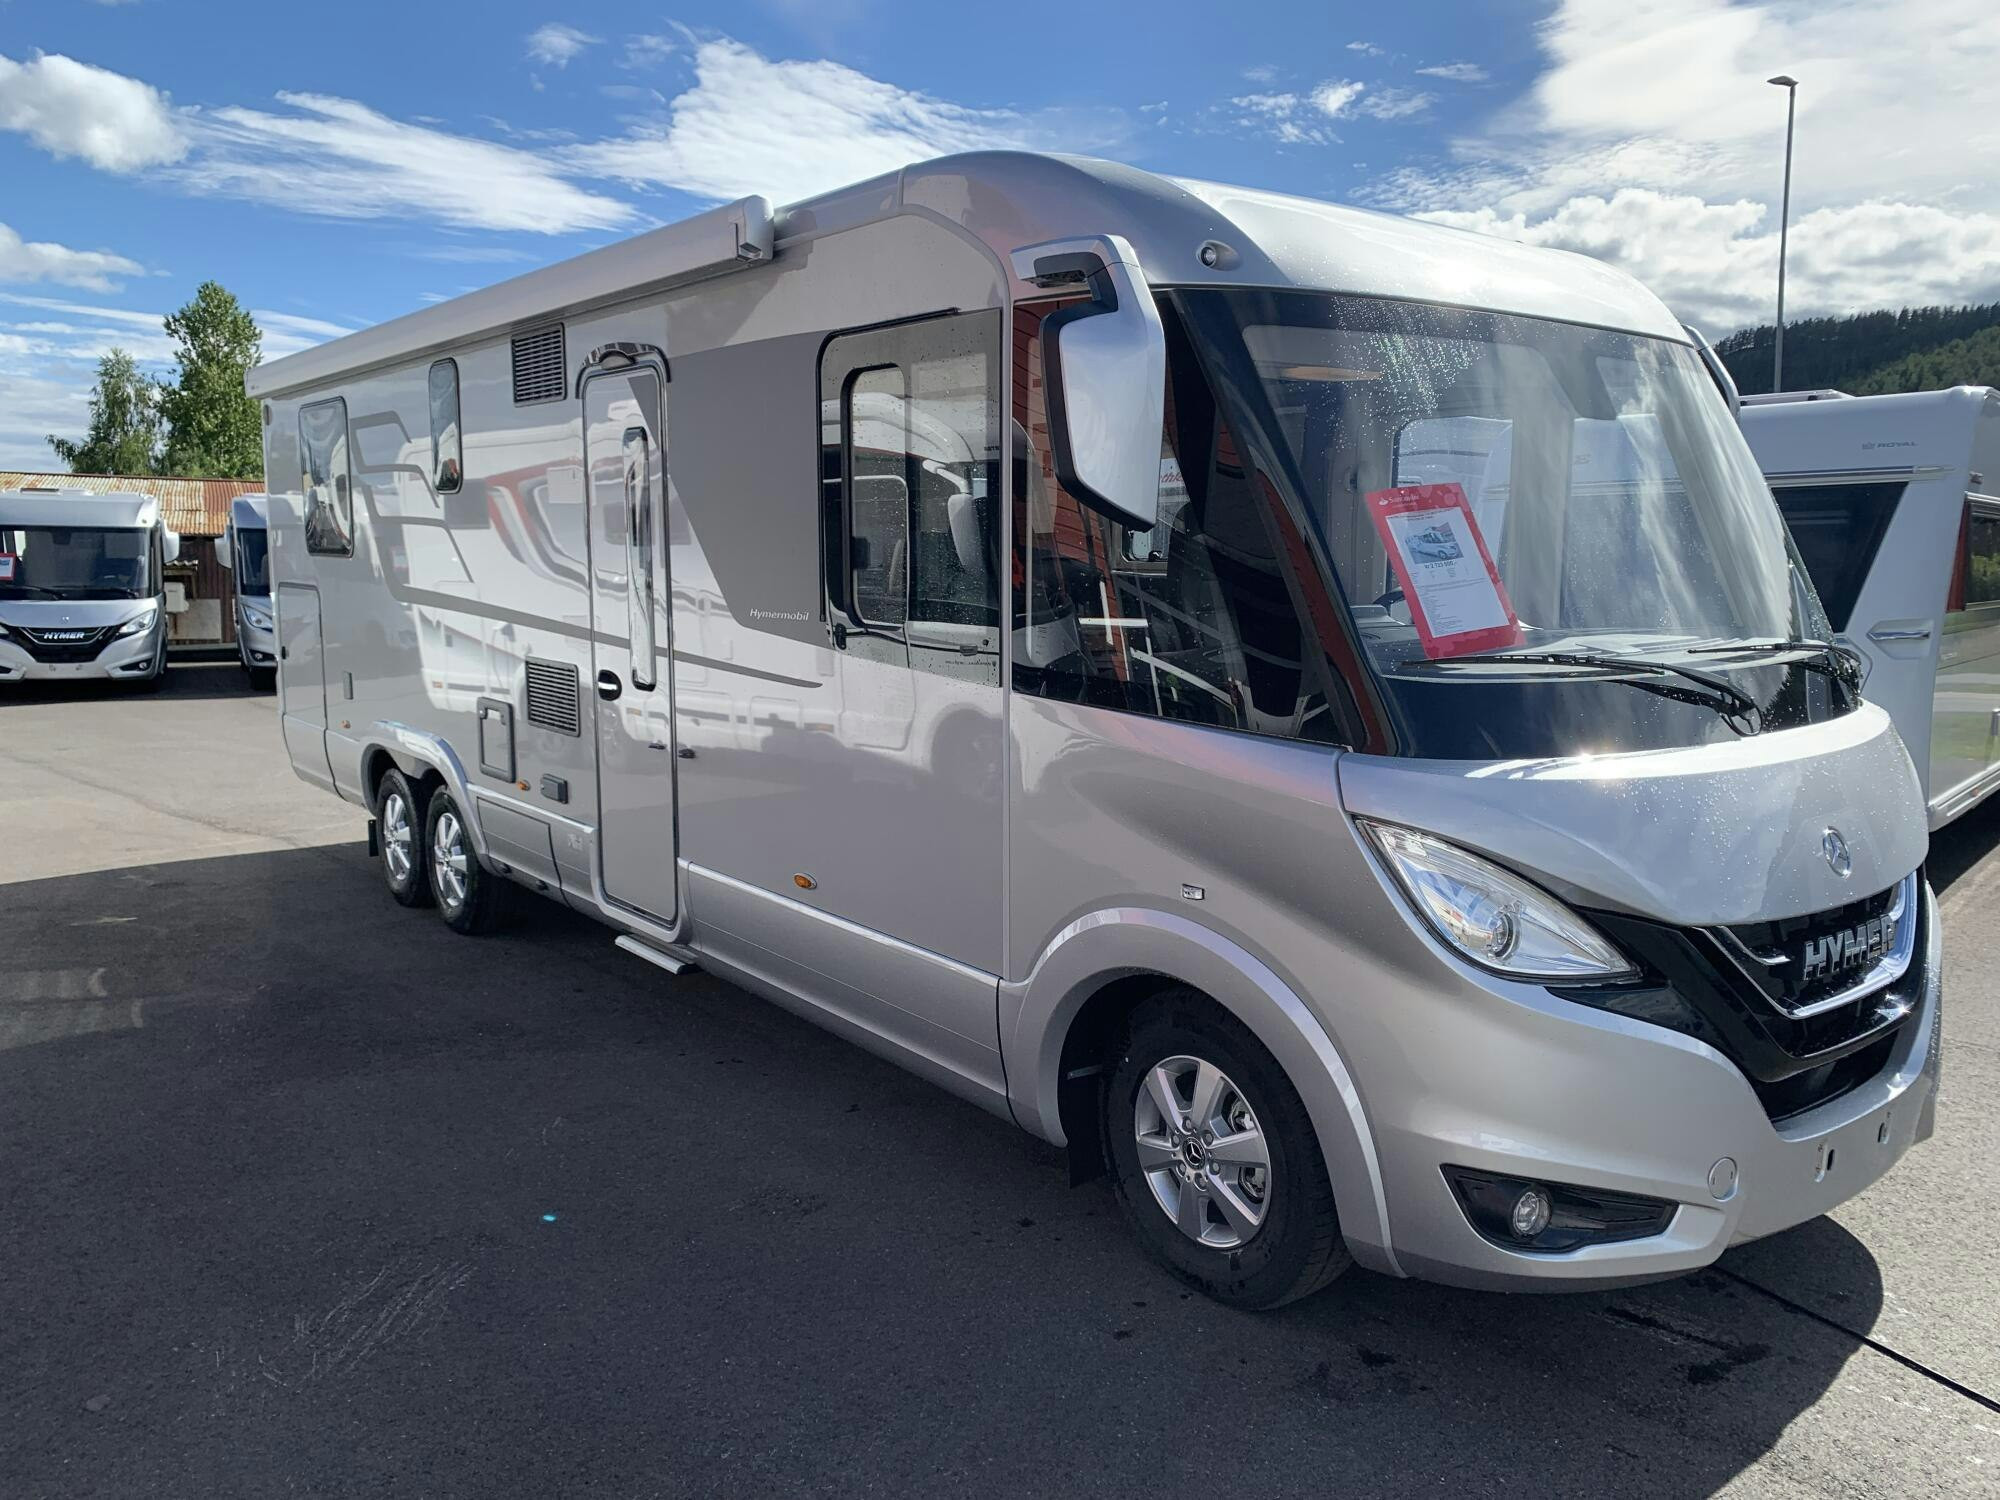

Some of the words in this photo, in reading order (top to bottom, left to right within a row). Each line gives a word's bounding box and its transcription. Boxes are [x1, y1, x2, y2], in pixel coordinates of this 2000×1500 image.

[749, 608, 809, 621] Hymermobil
[43, 631, 85, 640] HYMER
[1803, 914, 1896, 981] HYMER
